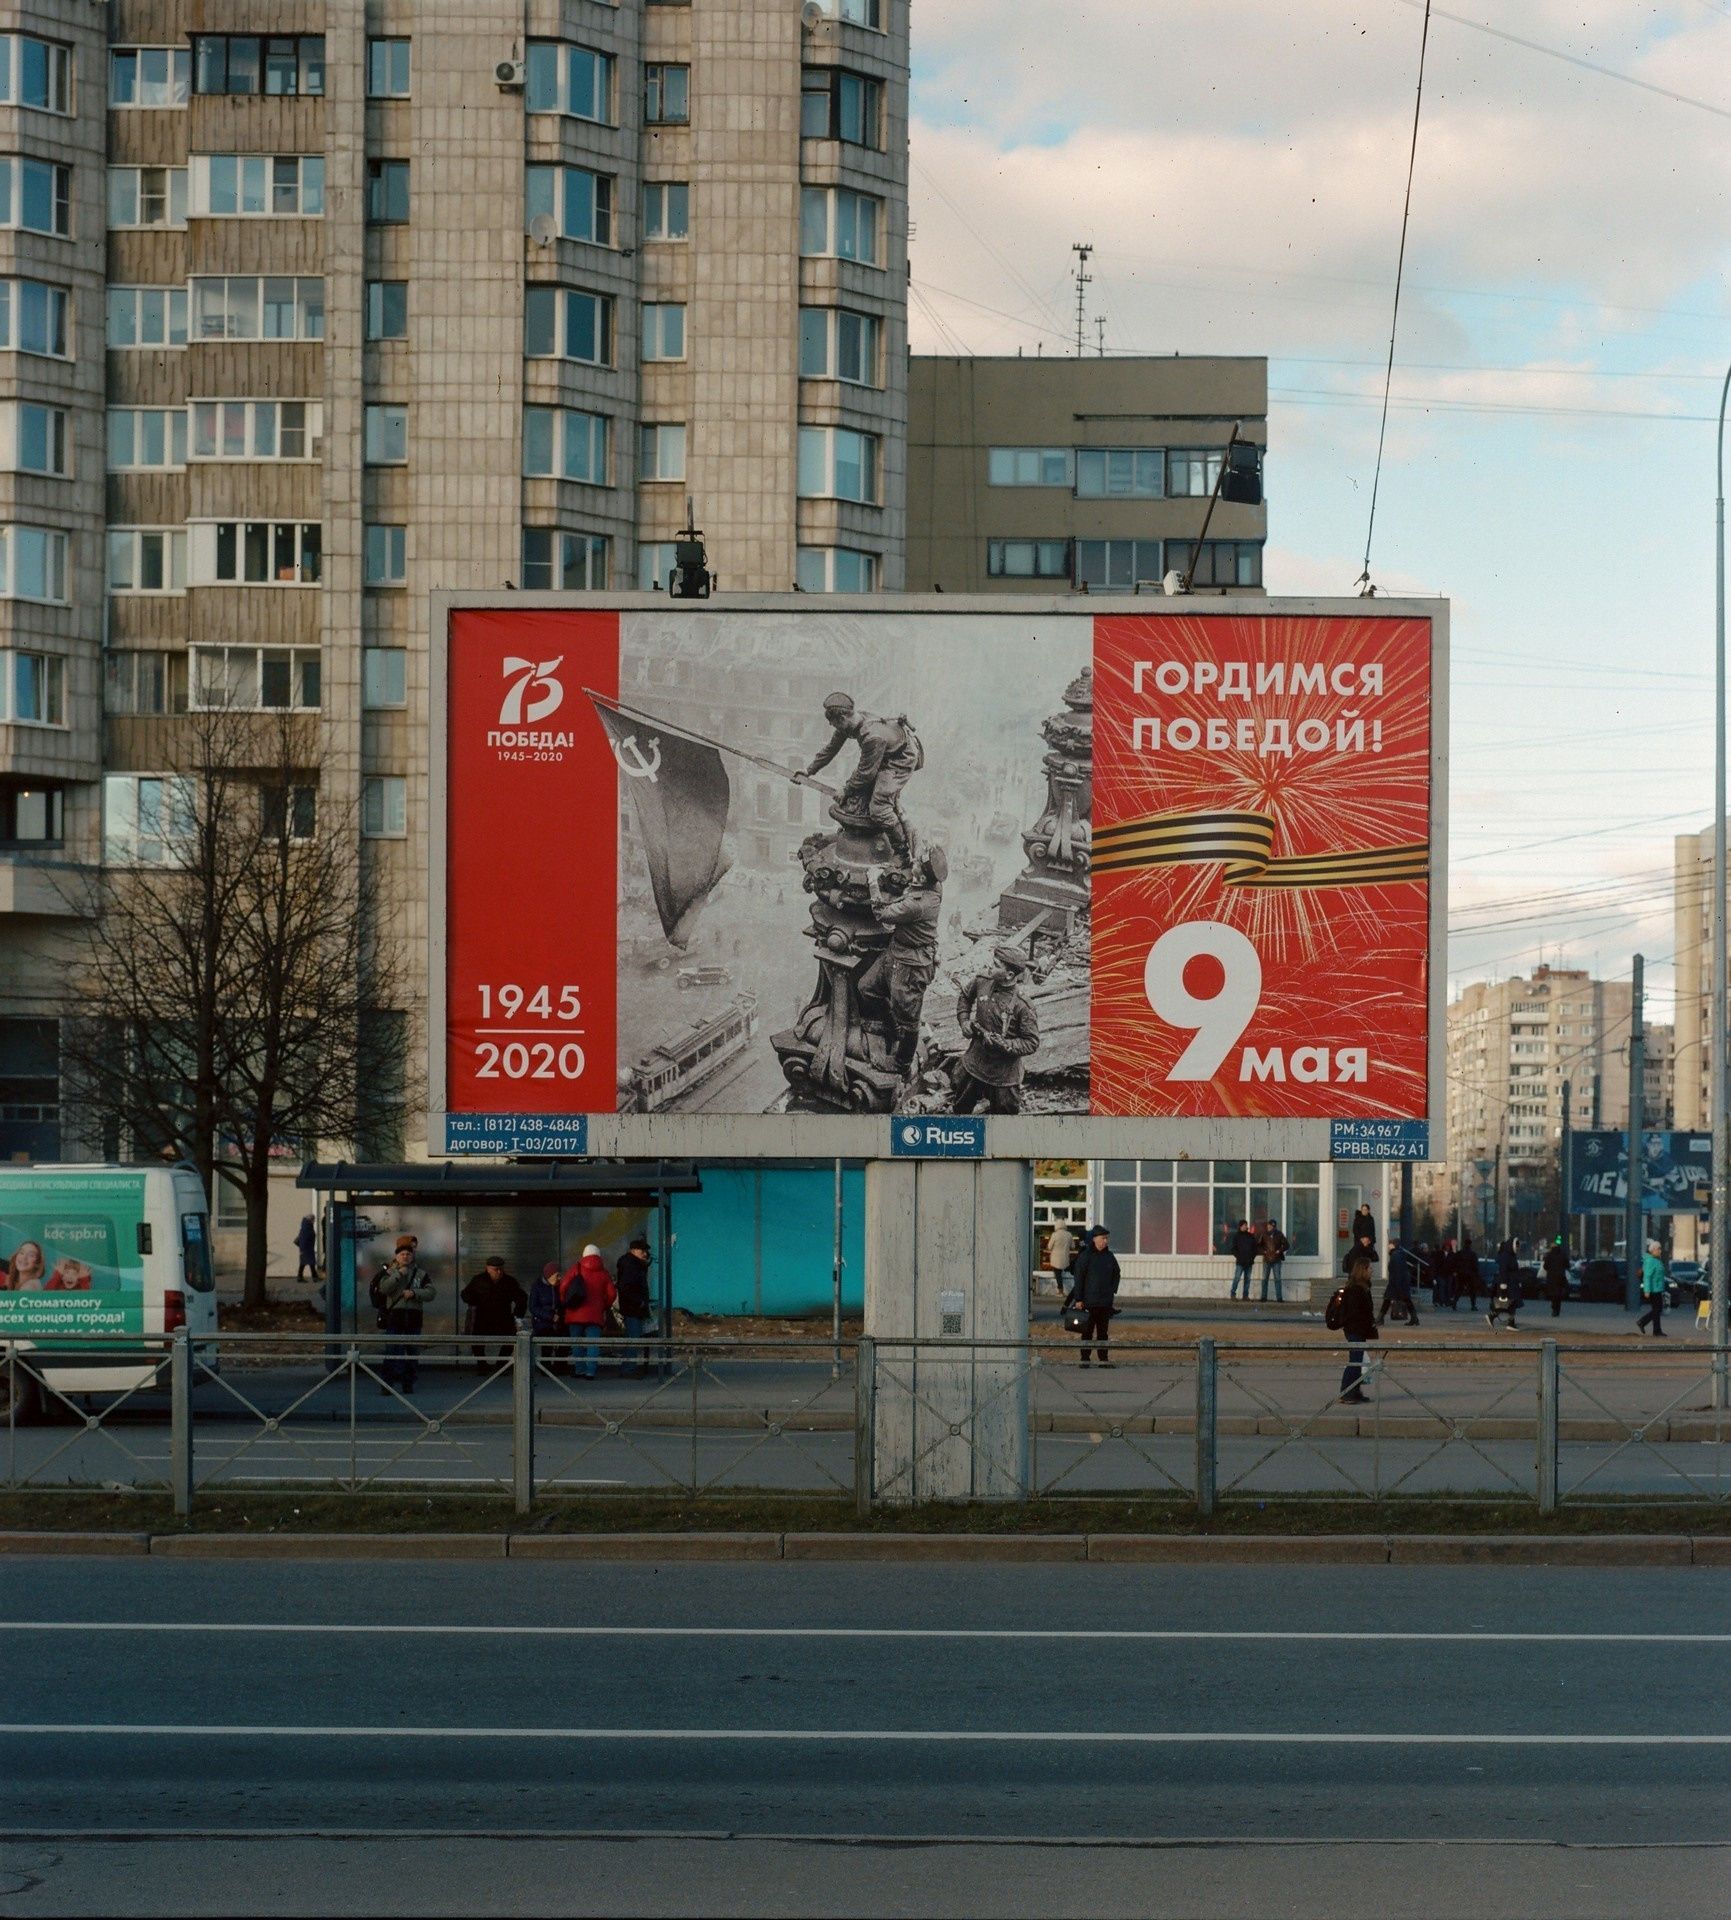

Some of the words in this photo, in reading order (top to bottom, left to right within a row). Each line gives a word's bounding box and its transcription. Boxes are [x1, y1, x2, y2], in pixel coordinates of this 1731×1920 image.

[499, 655, 564, 725] 75
[1133, 661, 1384, 701] ГОРДИМСЯ
[487, 731, 574, 750] ПОБЕДА!
[1132, 709, 1383, 758] ПОБЕДОЙ!
[498, 751, 563, 762] 1945-2020
[478, 984, 581, 1020] 1945
[1144, 921, 1262, 1082] 9
[1238, 1046, 1368, 1083] мая
[474, 1042, 585, 1079] 2020
[450, 1121, 480, 1131] тел.:
[484, 1118, 516, 1132] (812)
[520, 1119, 580, 1132] 438-4848
[450, 1139, 508, 1151] договор:
[511, 1137, 577, 1150] Т-03/2017
[926, 1127, 975, 1145] Russ
[1408, 1144, 1424, 1155] A1
[44, 1228, 107, 1242] kdc-spb.ru
[19, 1297, 102, 1311] Стоматологу
[27, 1313, 74, 1324] концов
[76, 1311, 125, 1325] города!
